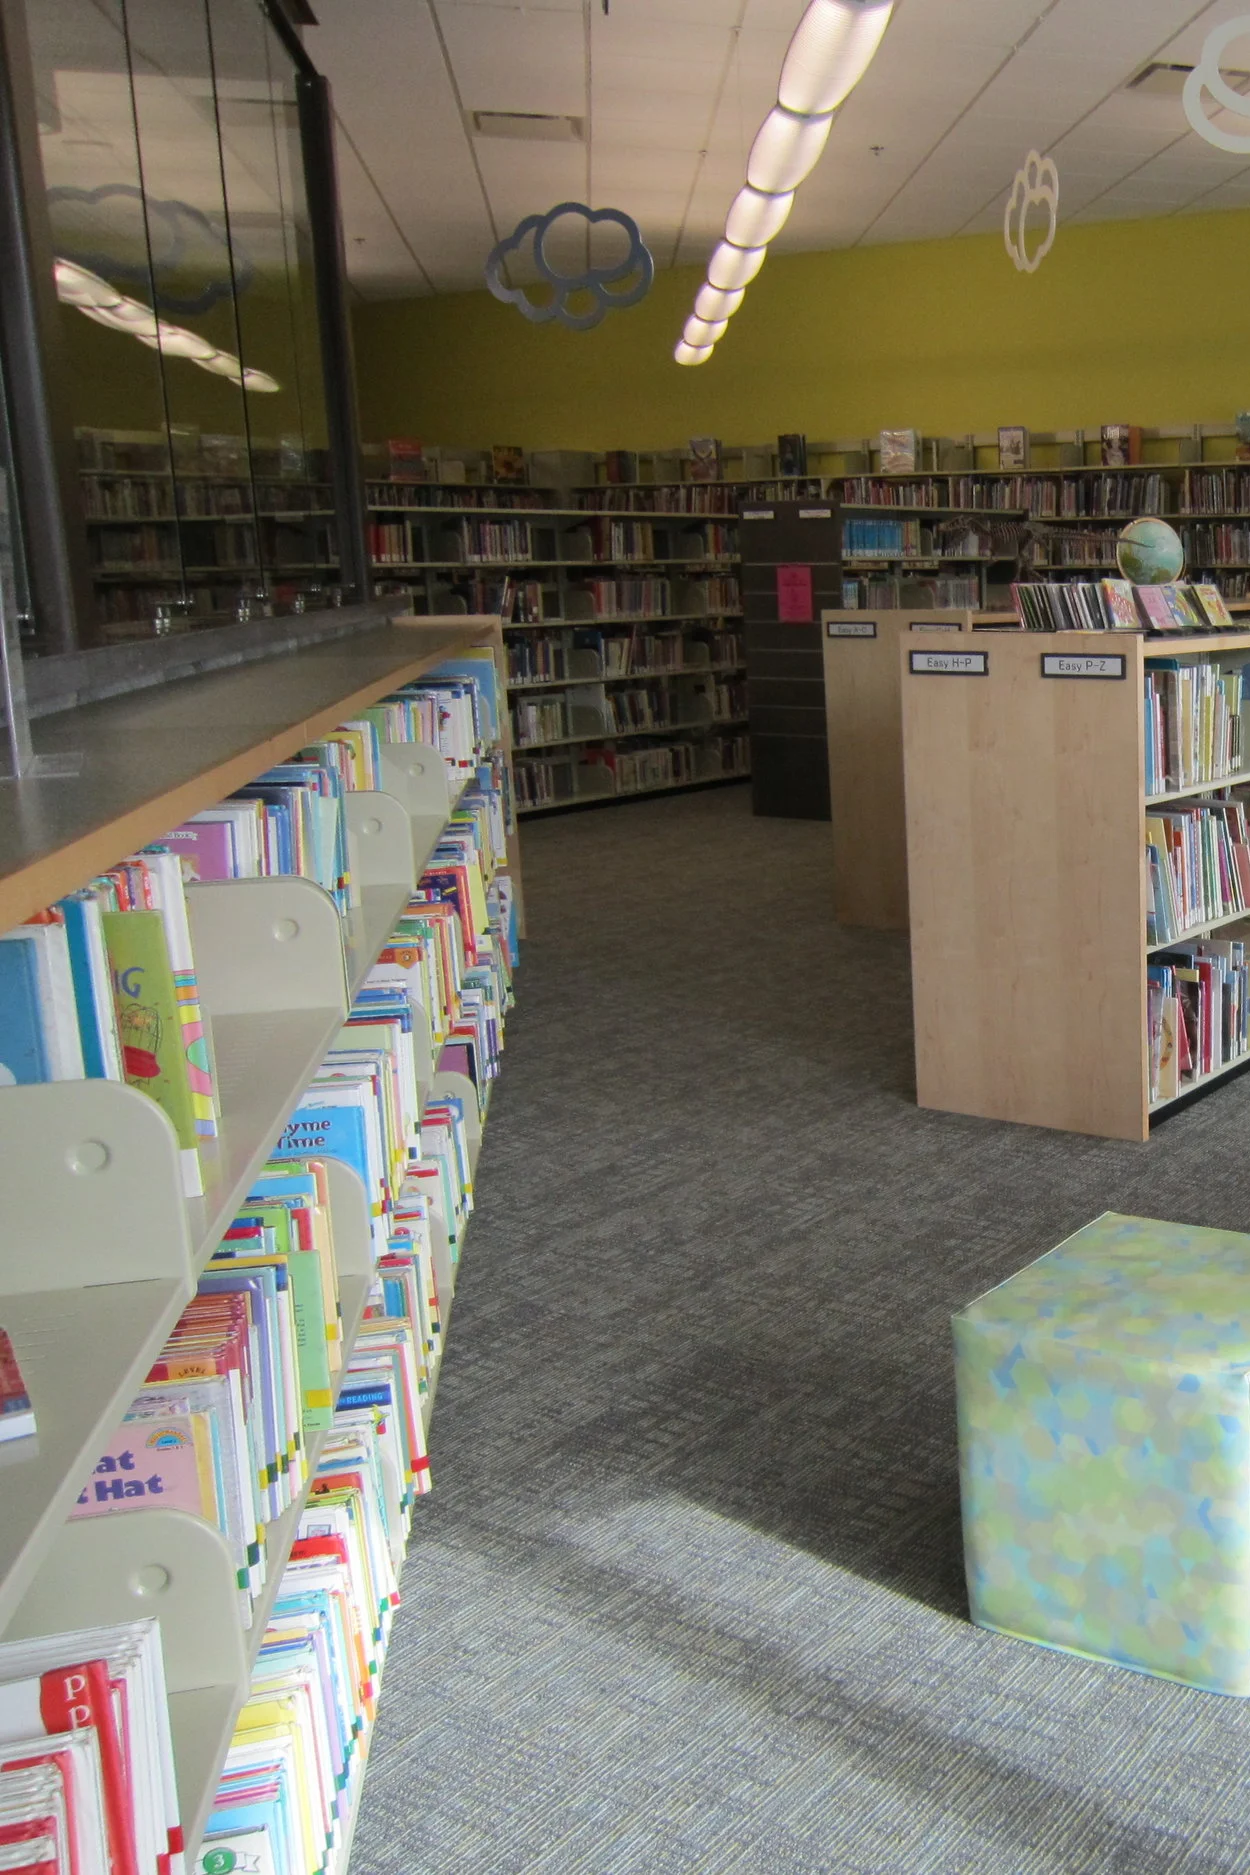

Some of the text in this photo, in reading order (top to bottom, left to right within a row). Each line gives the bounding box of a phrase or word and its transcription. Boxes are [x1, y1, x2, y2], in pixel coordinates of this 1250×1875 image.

[927, 657, 972, 669] Easy H-P
[1058, 660, 1106, 672] Easy P-Z
[284, 1120, 331, 1136] yme
[346, 1393, 383, 1405] READING
[92, 1450, 135, 1475] at
[94, 1473, 164, 1502] Hat
[213, 1854, 225, 1868] 3
